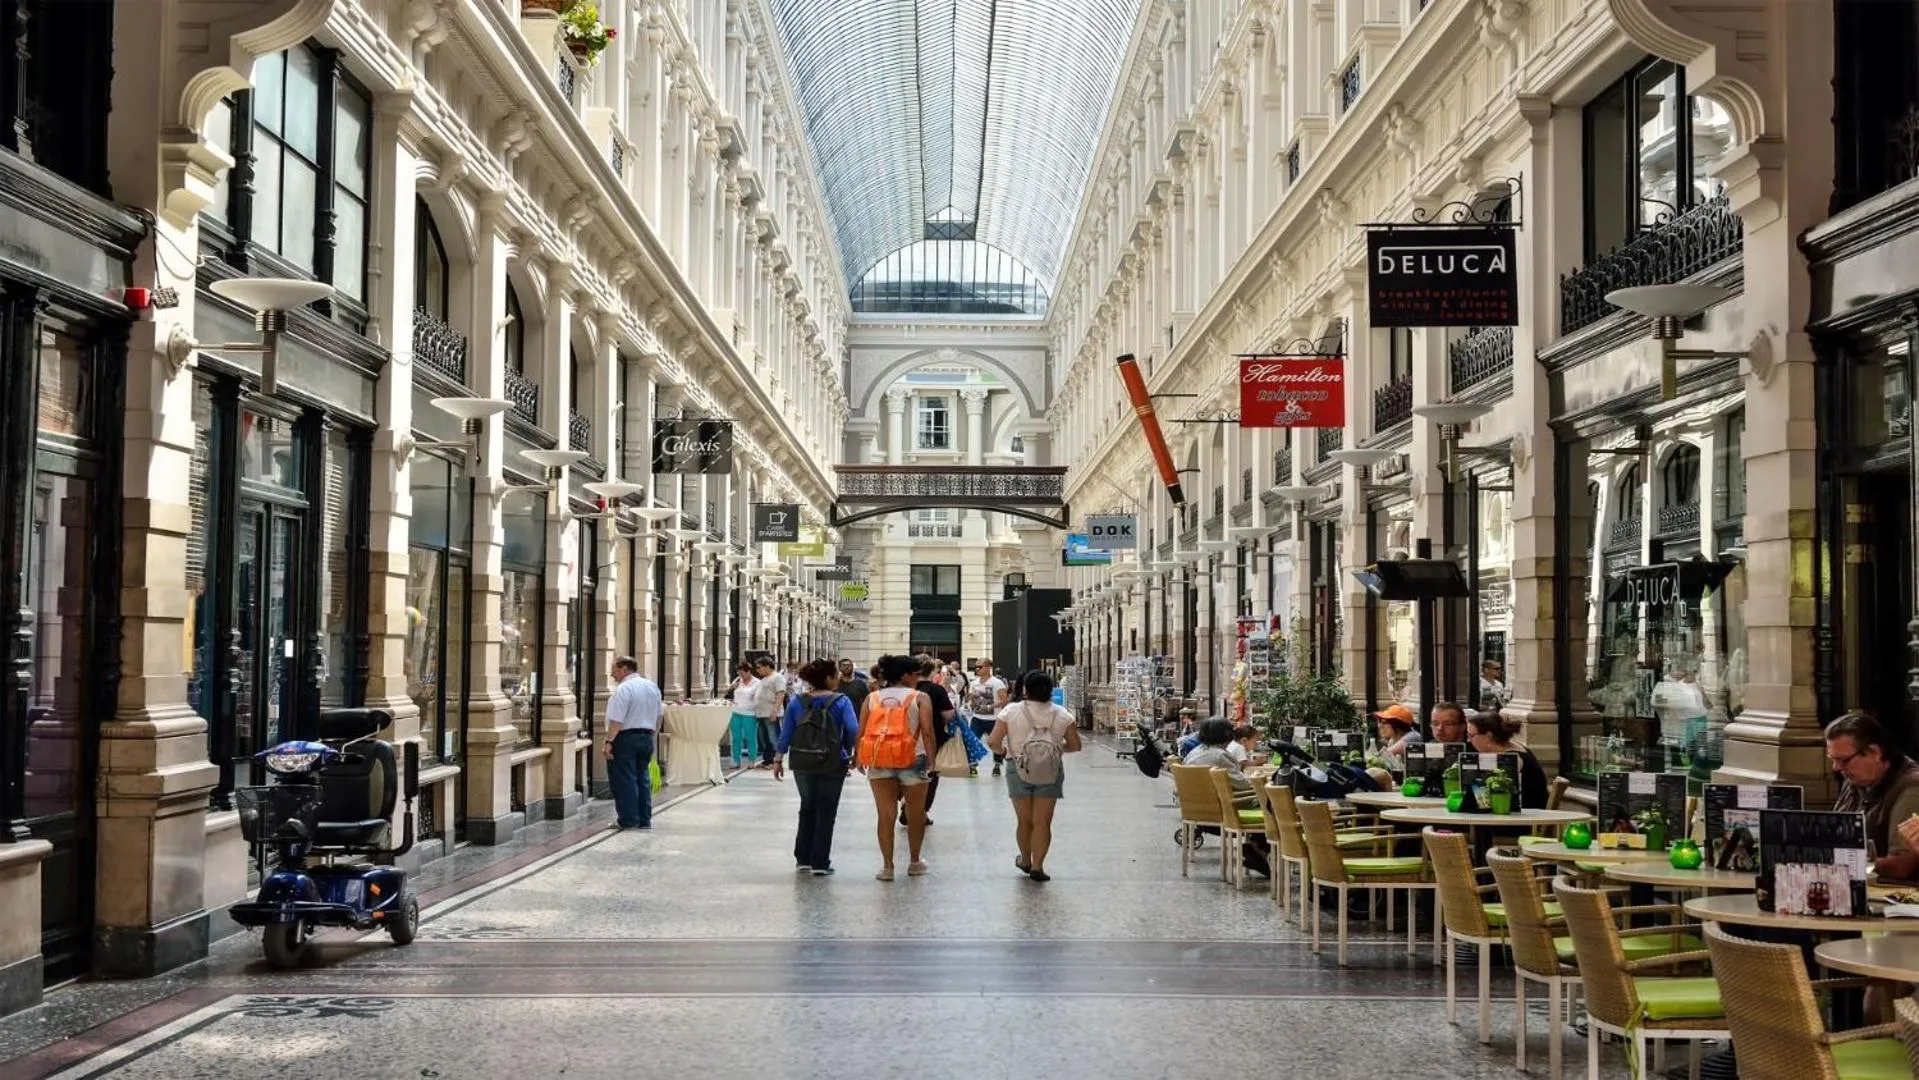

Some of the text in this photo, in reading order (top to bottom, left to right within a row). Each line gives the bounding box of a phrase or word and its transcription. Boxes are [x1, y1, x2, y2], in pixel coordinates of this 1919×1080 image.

[1378, 250, 1507, 275] DELUCA
[1243, 363, 1342, 383] Hamilton
[662, 435, 721, 455] Calexis
[1092, 525, 1131, 535] DOK
[1626, 573, 1681, 606] DELUCA
